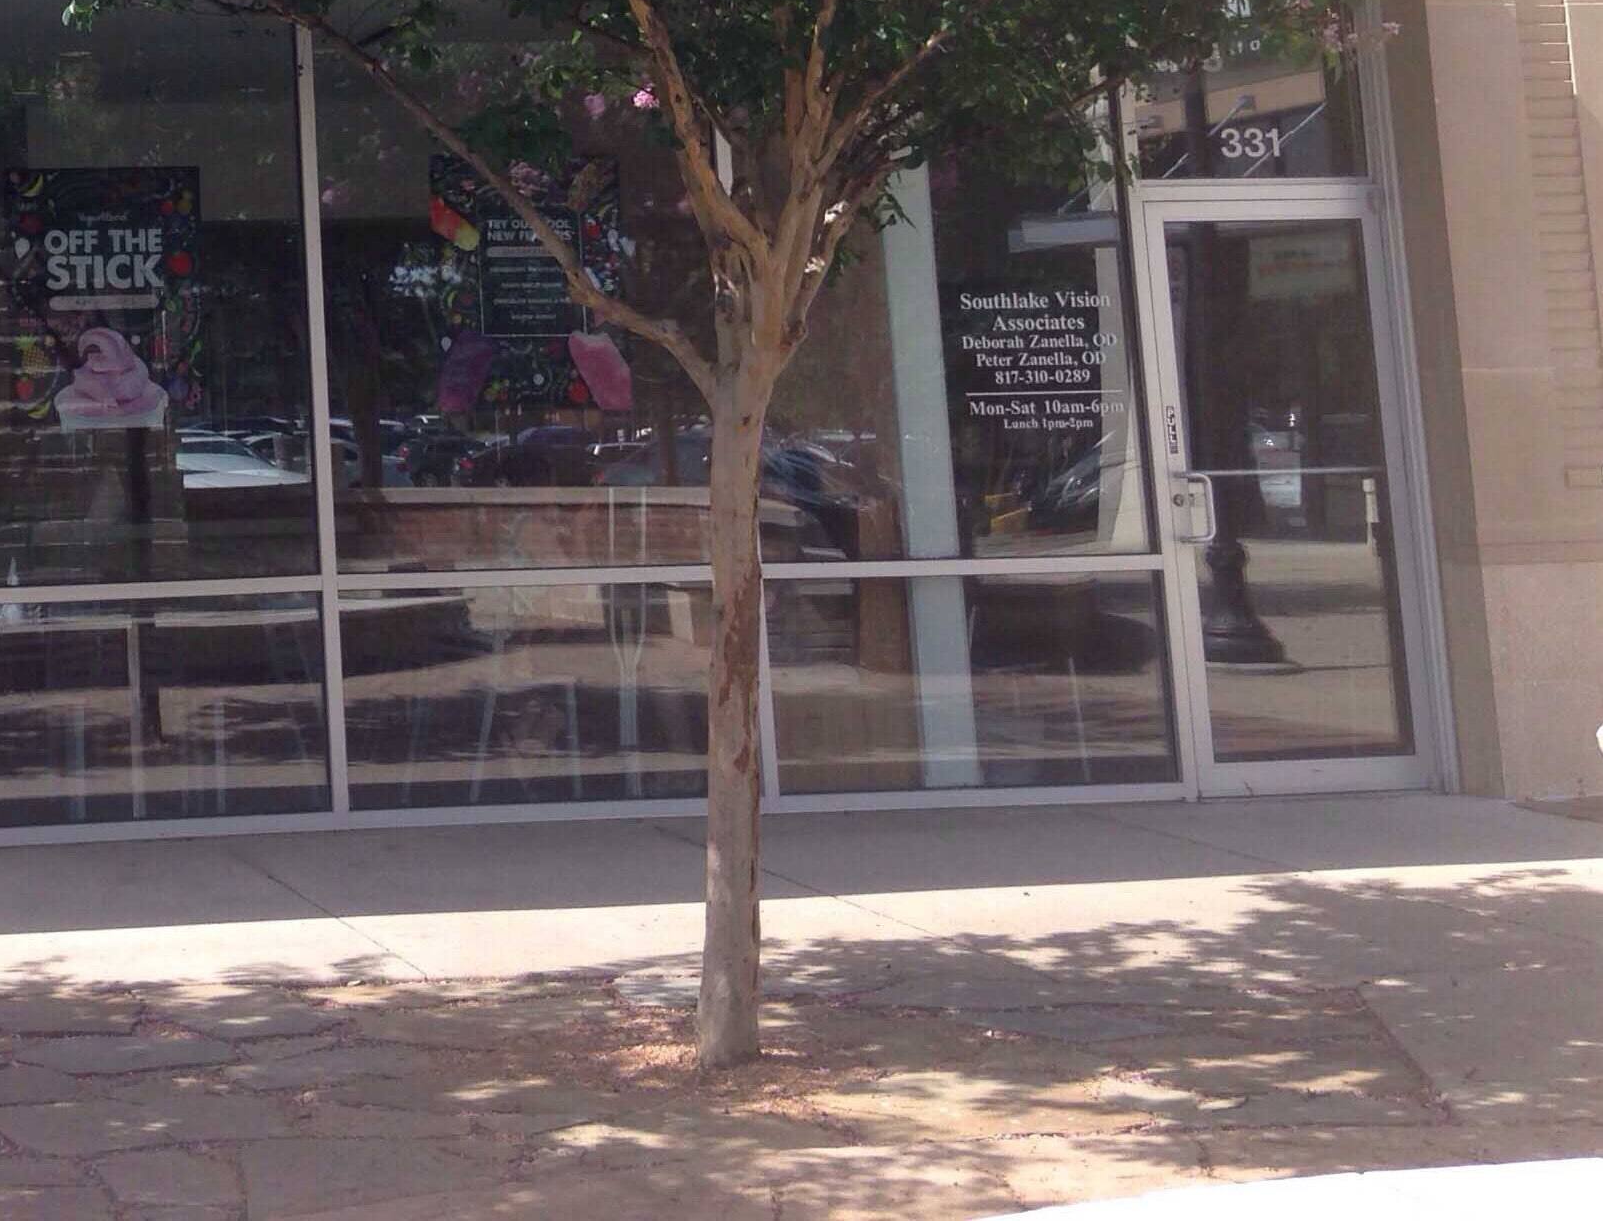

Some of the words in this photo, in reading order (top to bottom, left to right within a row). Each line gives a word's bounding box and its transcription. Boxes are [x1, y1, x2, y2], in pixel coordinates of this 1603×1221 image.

[1220, 128, 1282, 158] 331
[487, 219, 507, 229] TRY
[511, 219, 533, 229] OU
[43, 229, 98, 255] OFF
[108, 228, 163, 253] THE
[487, 231, 515, 241] NEW
[46, 254, 165, 291] STICK
[960, 292, 1049, 310] Southlake
[1055, 291, 1111, 308] Vision
[992, 314, 1085, 331] Associates
[962, 336, 1024, 350] Deborah
[1028, 334, 1089, 349] Zanella,
[1092, 333, 1117, 347] OD
[976, 353, 1013, 367] Peter
[1018, 352, 1078, 367] Zanella,
[1081, 351, 1107, 365] OD
[995, 370, 1091, 385] 817-310-0289
[969, 400, 1036, 416] Mon-Sat
[1044, 398, 1125, 417] 10am-6pm
[1003, 418, 1038, 429] Lunch
[1042, 417, 1094, 431] 1pm-2pm
[1166, 409, 1177, 443] PULL
